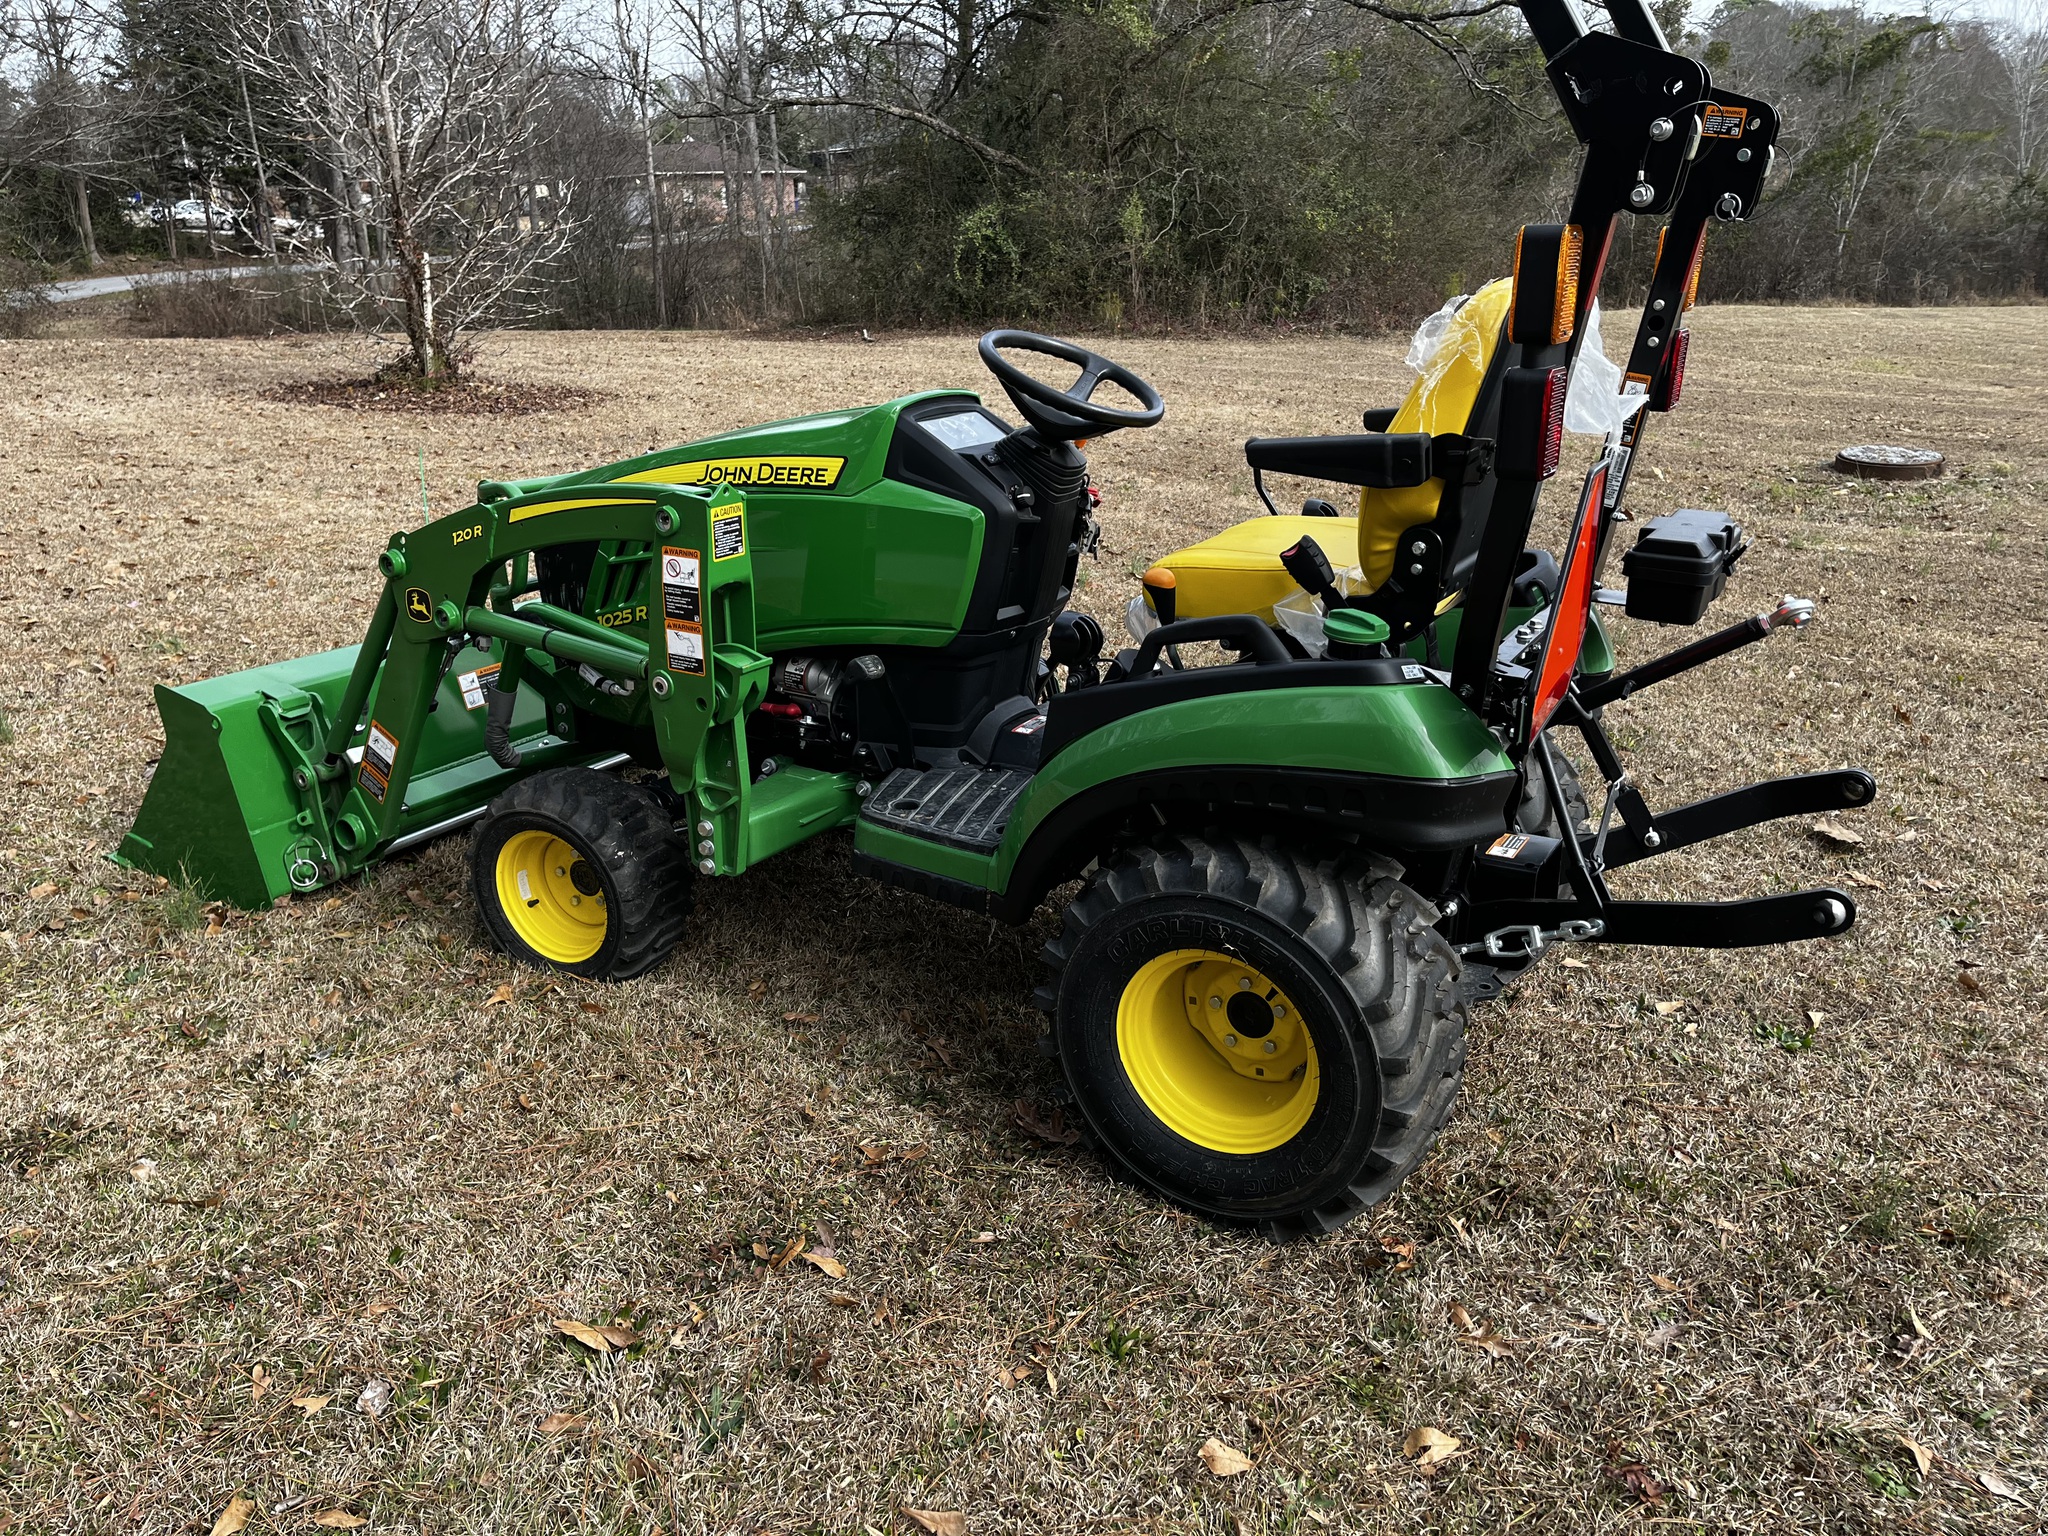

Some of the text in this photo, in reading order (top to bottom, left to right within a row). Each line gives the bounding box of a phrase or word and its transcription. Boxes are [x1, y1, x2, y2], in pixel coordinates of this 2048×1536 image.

[697, 463, 829, 484] JOHN DEERE
[720, 505, 741, 516] CAUTION
[668, 548, 698, 558] WARNING
[672, 623, 700, 634] WARNING
[1106, 918, 1279, 964] CARLISLE
